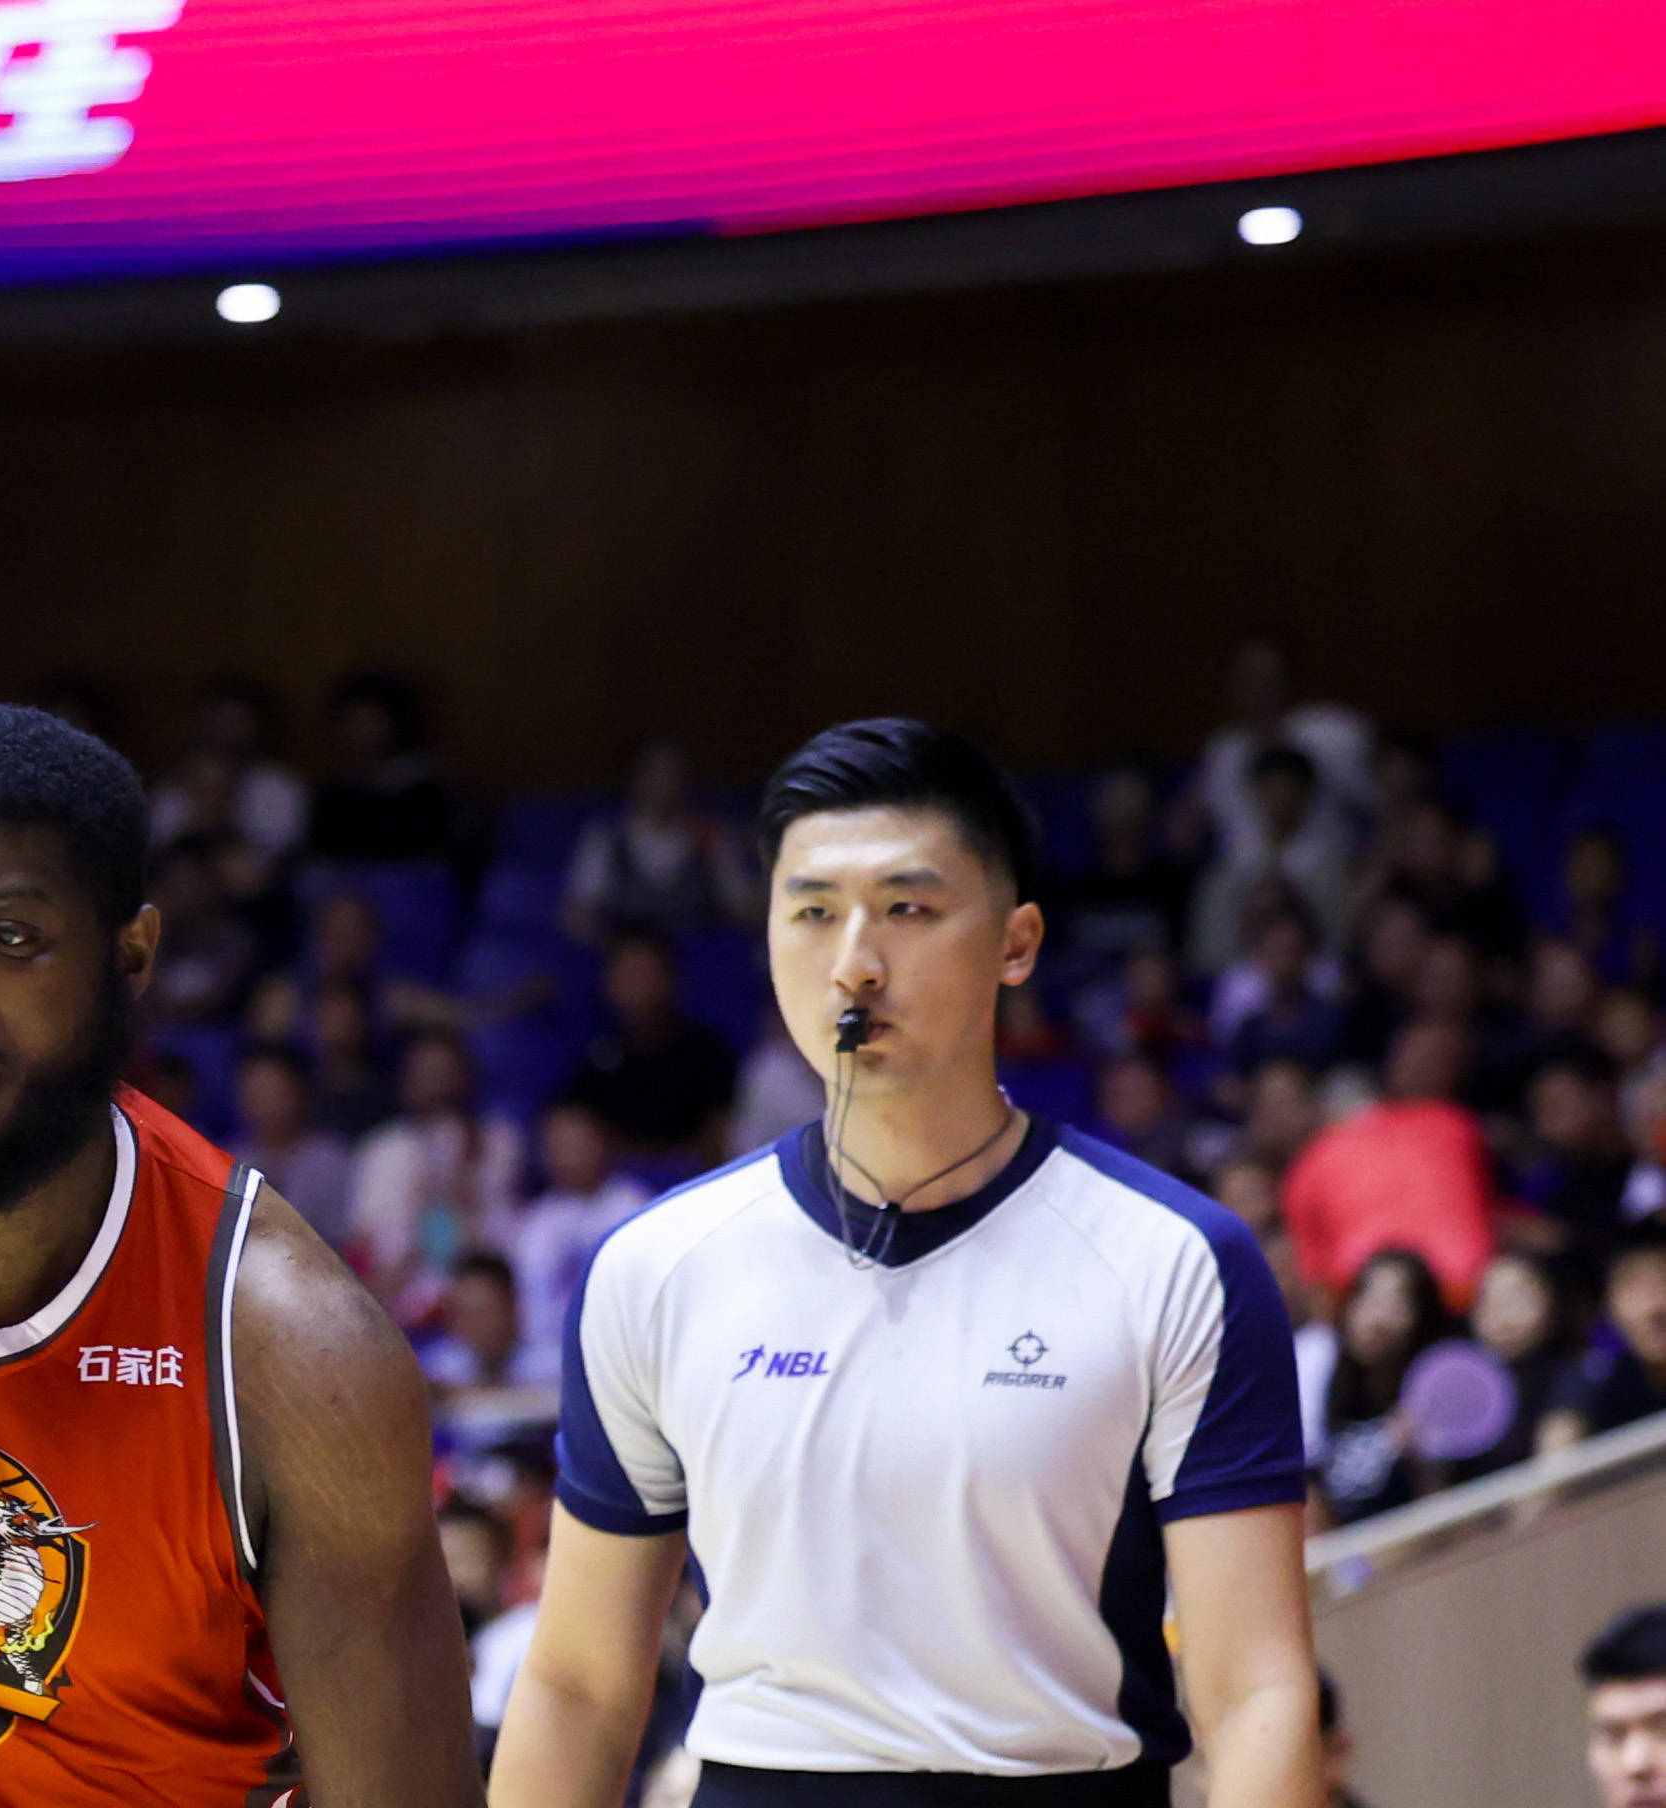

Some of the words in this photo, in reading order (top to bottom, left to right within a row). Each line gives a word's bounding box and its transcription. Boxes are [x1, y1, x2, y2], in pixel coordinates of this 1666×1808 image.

[76, 1344, 184, 1389] 石家庄
[765, 1350, 829, 1378] NBL
[982, 1371, 1068, 1391] RIGORER
